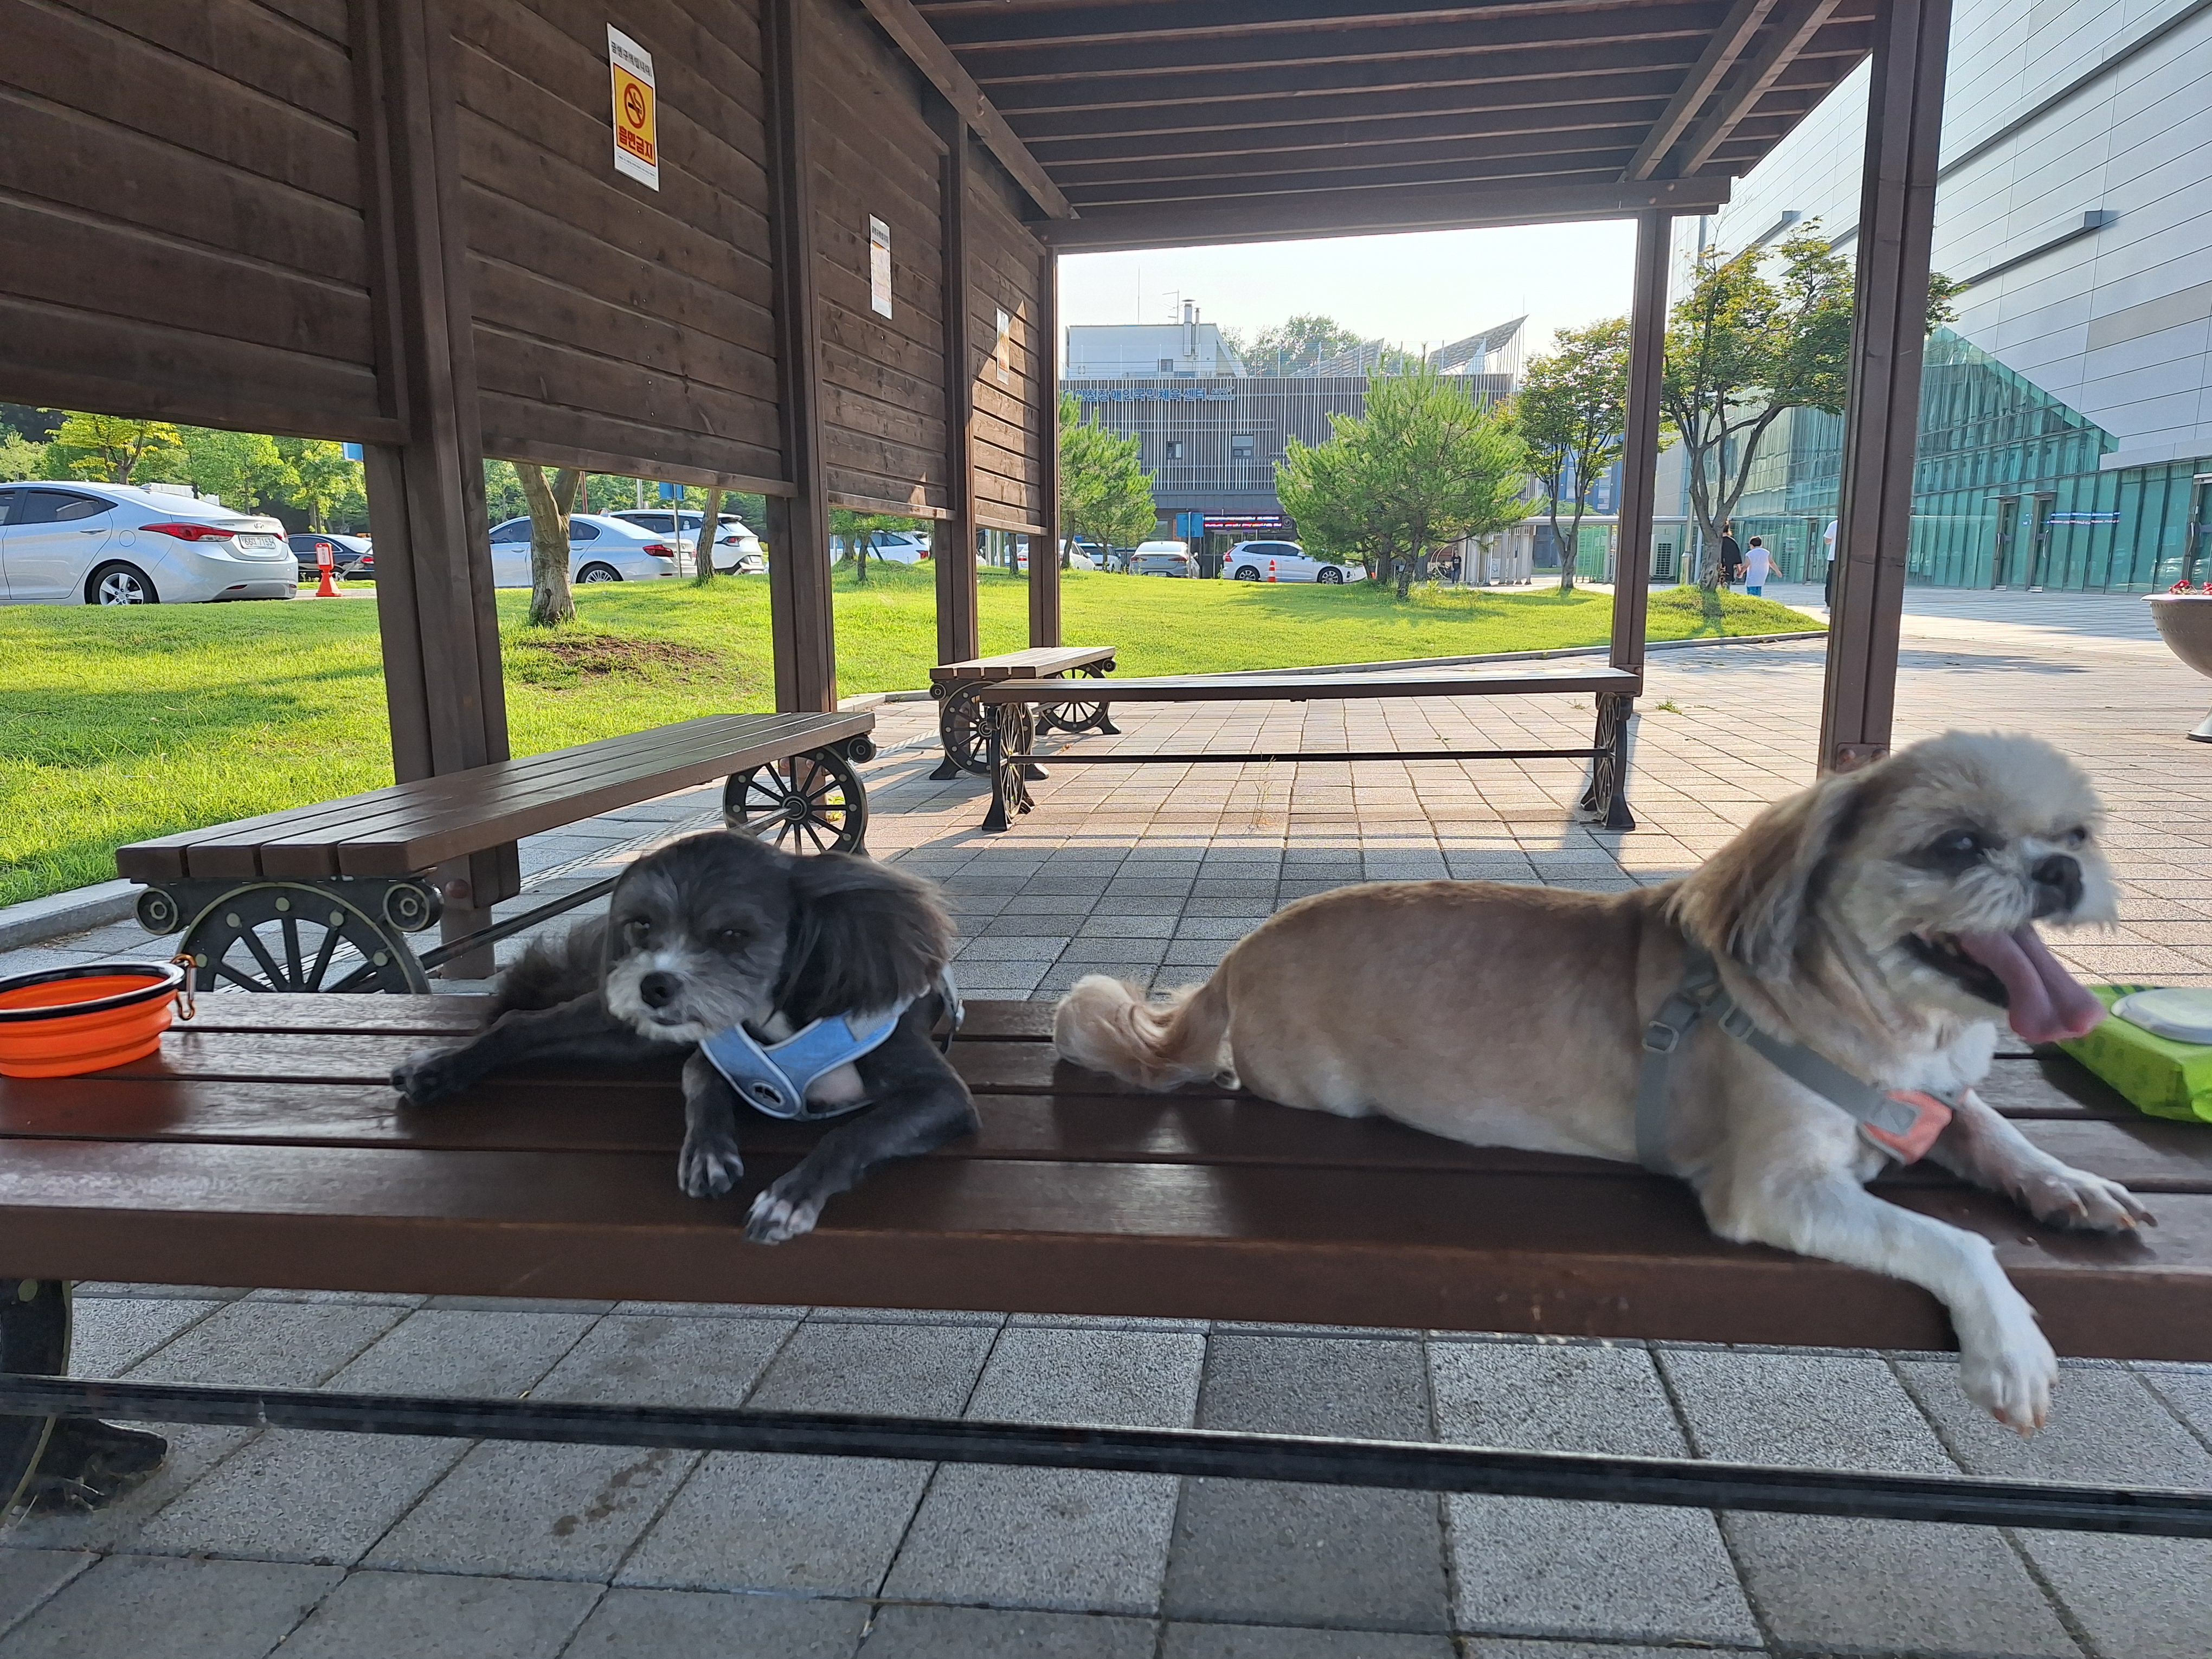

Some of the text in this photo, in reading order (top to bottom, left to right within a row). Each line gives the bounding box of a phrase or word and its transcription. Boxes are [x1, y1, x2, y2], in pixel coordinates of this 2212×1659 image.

[619, 125, 653, 160] 흡연금지
[1075, 388, 1205, 401] 인천장애인국민체육센터
[257, 538, 273, 546] 7153
